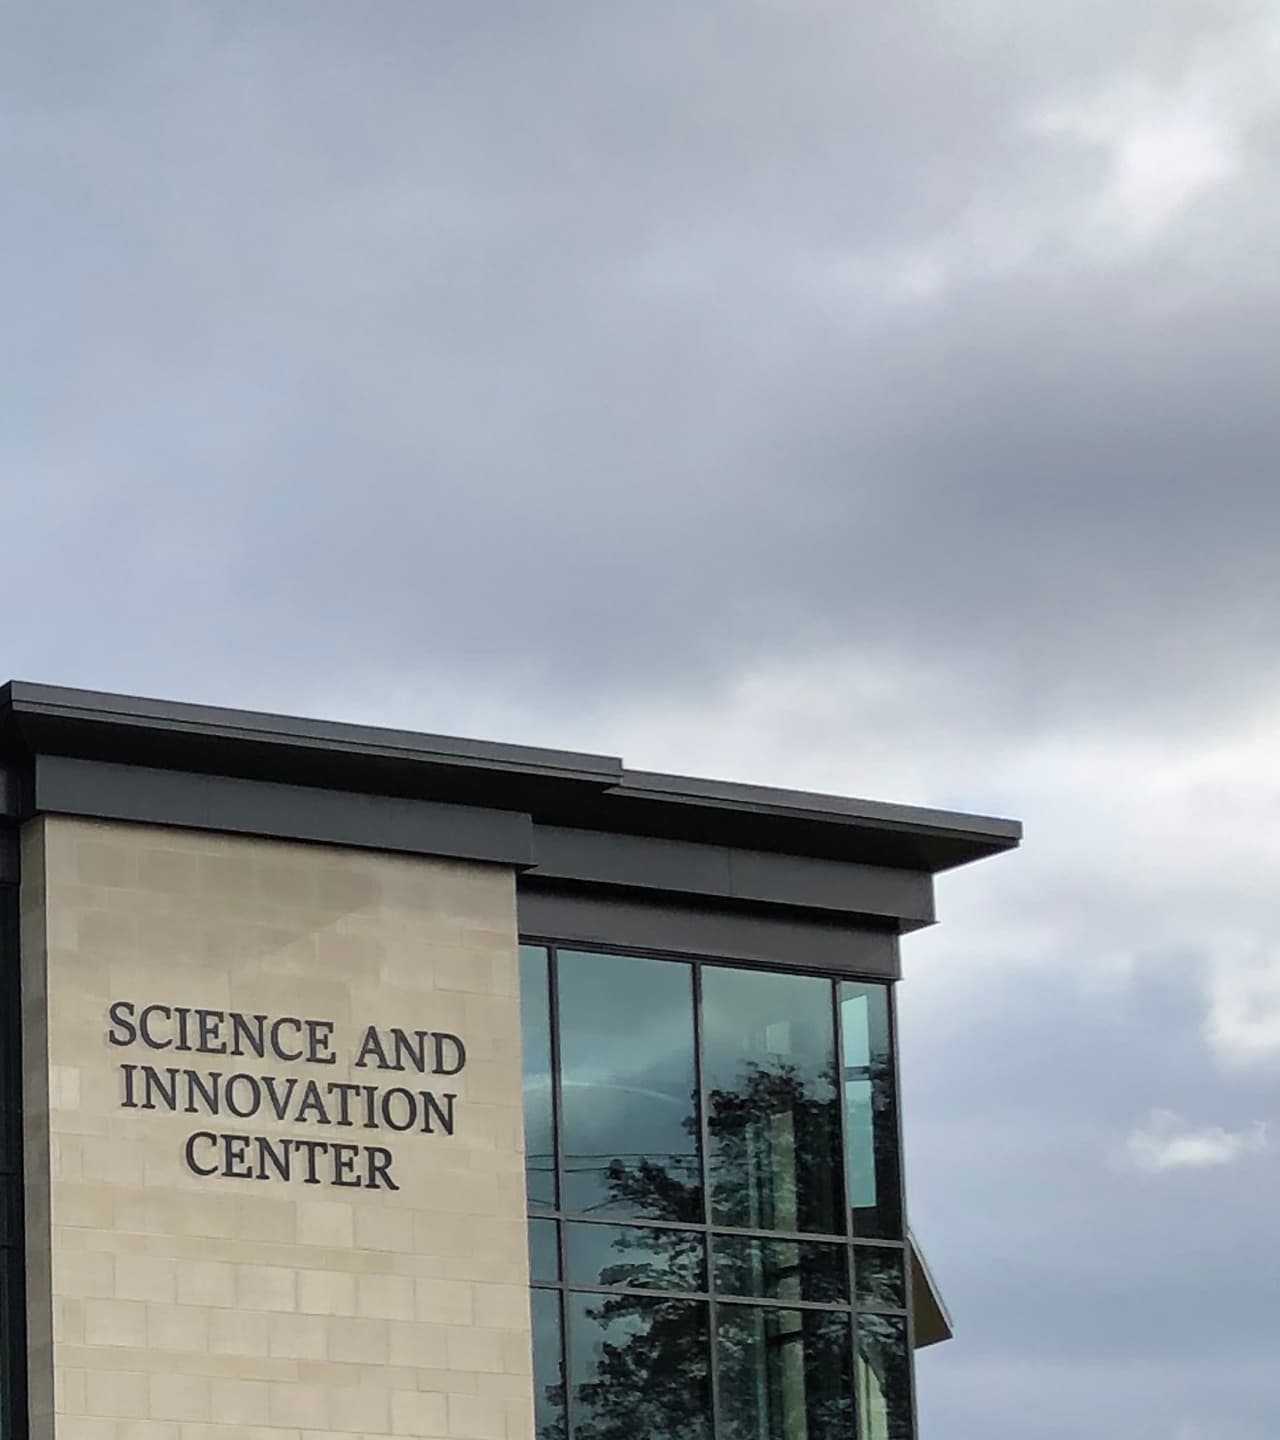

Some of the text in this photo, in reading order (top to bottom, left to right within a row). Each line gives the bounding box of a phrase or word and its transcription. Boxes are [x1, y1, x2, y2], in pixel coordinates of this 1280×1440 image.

[108, 1001, 467, 1076] SCIENCE AND
[119, 1063, 458, 1136] INNOVATION
[184, 1131, 400, 1191] CENTER
